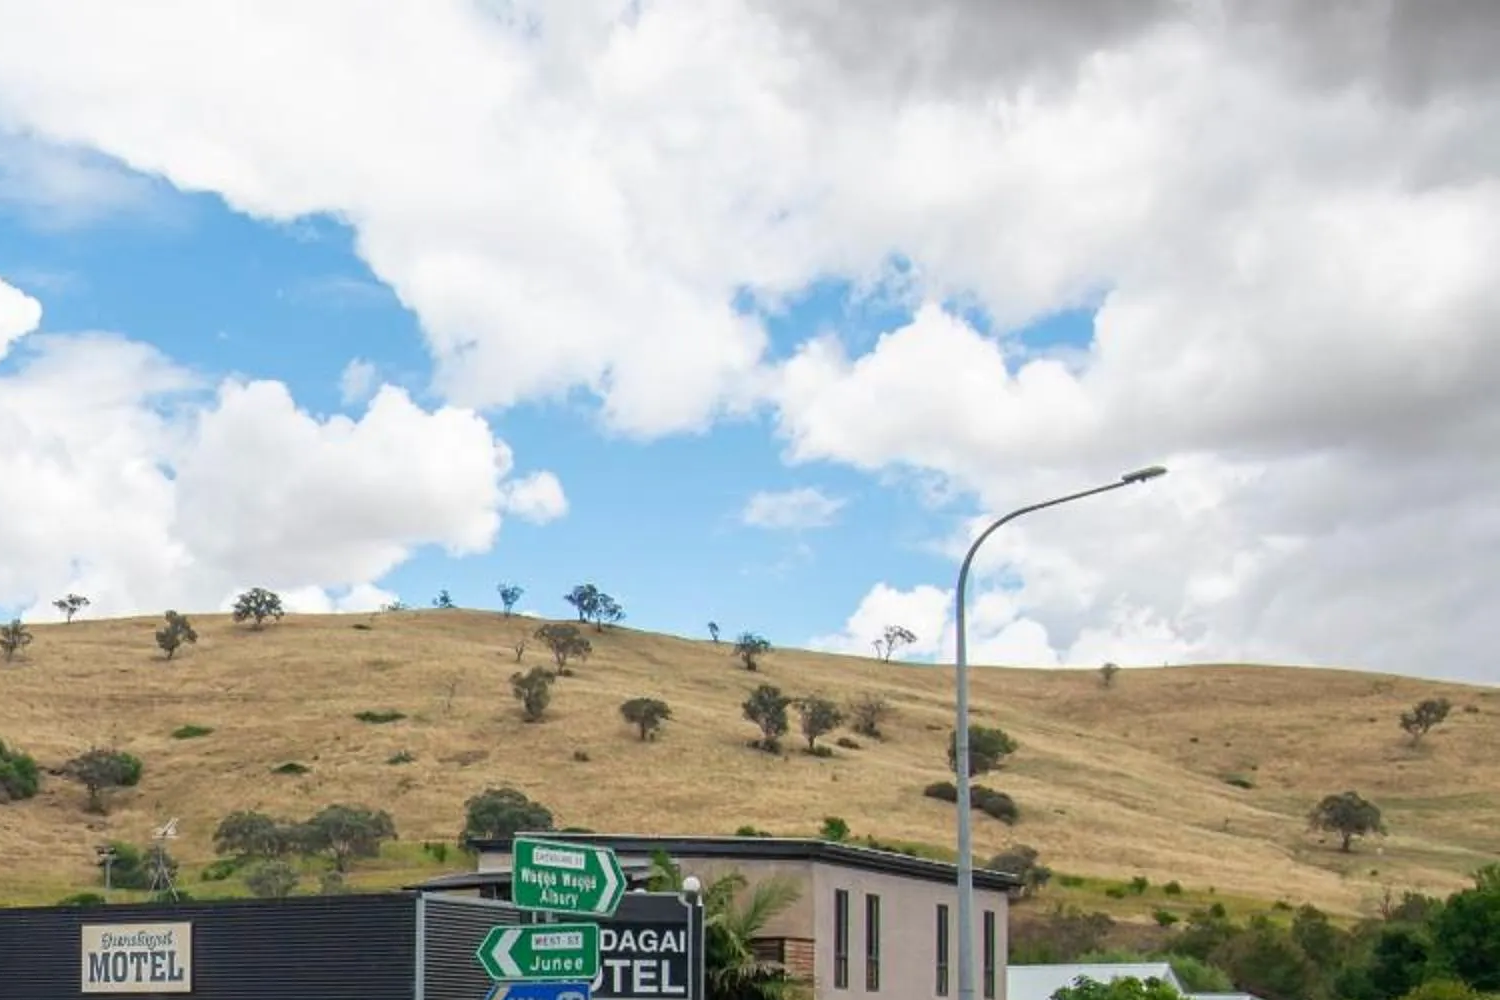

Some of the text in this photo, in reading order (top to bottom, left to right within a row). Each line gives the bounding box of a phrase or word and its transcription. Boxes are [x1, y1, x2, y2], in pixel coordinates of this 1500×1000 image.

[521, 867, 597, 893] Wagga Wagga
[599, 929, 686, 953] DAGAI
[88, 951, 184, 983] MOTEL
[529, 955, 583, 971] Junee
[590, 959, 685, 994] TEL
